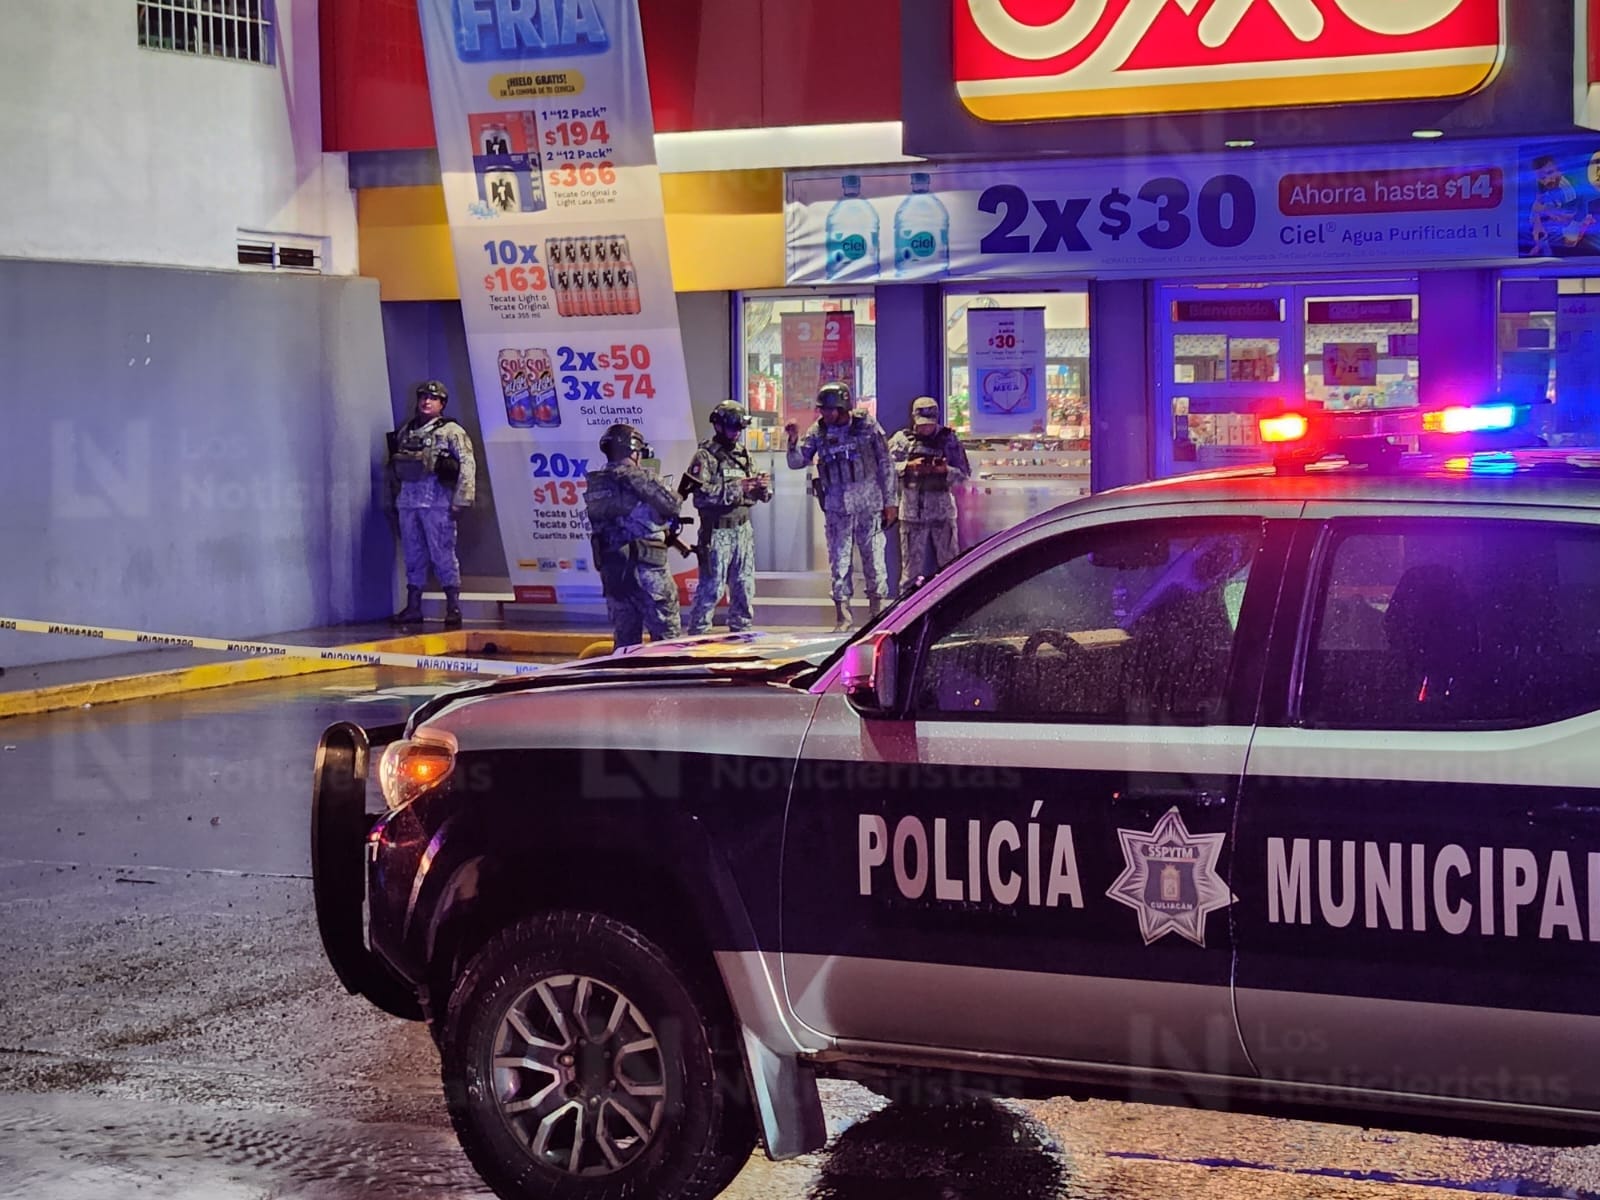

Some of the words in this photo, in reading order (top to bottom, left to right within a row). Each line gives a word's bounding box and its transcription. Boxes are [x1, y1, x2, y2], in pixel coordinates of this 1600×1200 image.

[535, 74, 567, 85] GRATIS!
[541, 111, 547, 120] 1
[545, 120, 610, 147] $194
[546, 152, 554, 161] 2
[550, 161, 617, 187] $366
[553, 191, 579, 199] Tecate
[580, 189, 610, 198] Original
[1289, 183, 1368, 206] Ahorra
[1374, 180, 1440, 201] hasta
[1444, 174, 1494, 200] $14
[977, 173, 1257, 255] 2x$30
[1341, 229, 1383, 247] Agua
[1389, 224, 1477, 241] Purificada
[842, 239, 865, 251] ciel
[911, 236, 934, 249] ciel
[484, 240, 540, 265] 10x
[484, 266, 548, 292] $163
[490, 295, 516, 303] Tecate
[518, 294, 540, 305] Light
[490, 303, 517, 311] Tecate
[518, 302, 550, 311] Original
[988, 334, 1016, 349] $30
[557, 344, 651, 372] 2x$50
[561, 374, 656, 401] 3x$74
[580, 406, 597, 415] Sol
[600, 405, 643, 415] Clamato
[586, 416, 612, 426] Latón
[632, 416, 644, 425] ml
[530, 453, 589, 478] 20x
[534, 509, 567, 519] Tecate
[570, 509, 589, 522] Lig
[534, 520, 567, 529] Tecate
[570, 519, 592, 531] Orig
[533, 532, 567, 540] Cuartito
[858, 799, 1084, 909] POLICÍA
[1148, 845, 1193, 858] SSPYTM
